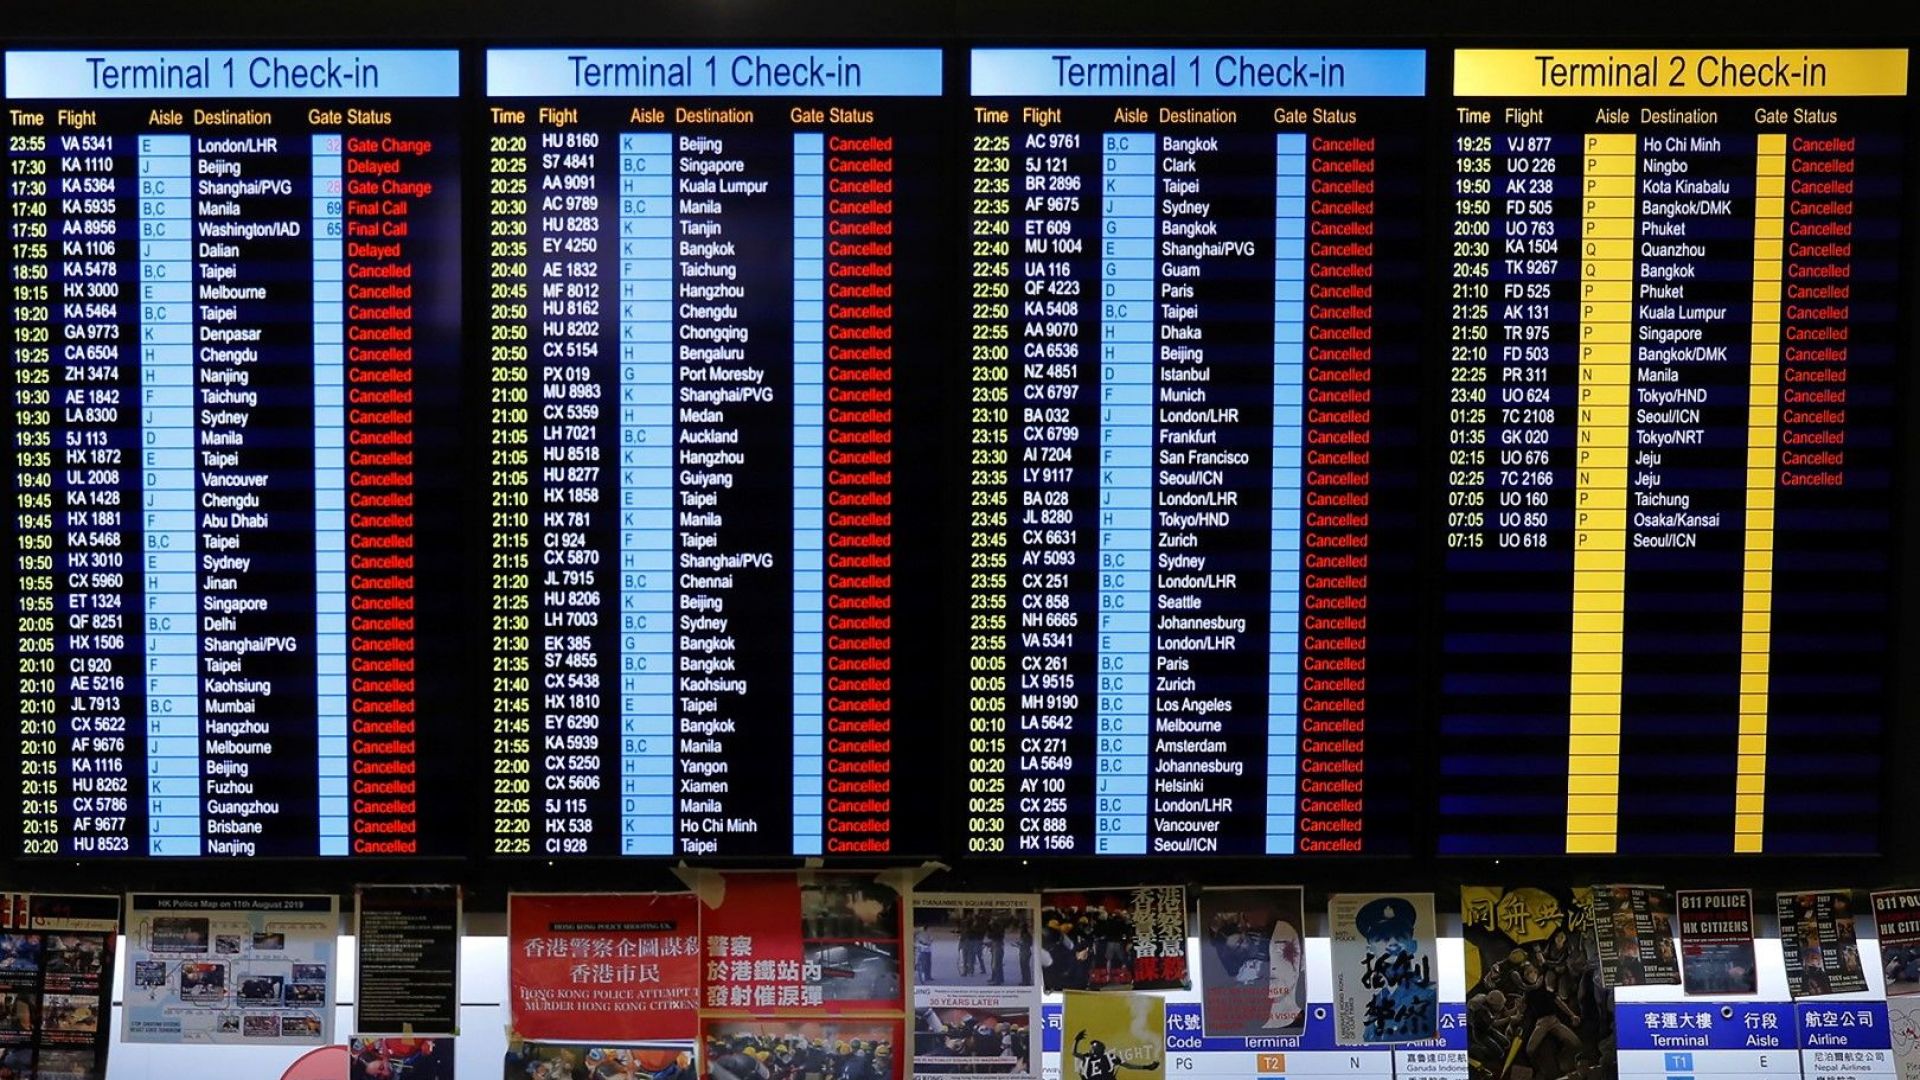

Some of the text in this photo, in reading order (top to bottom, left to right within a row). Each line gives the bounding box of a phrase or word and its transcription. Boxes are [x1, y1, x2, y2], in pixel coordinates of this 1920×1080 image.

[86, 57, 378, 88] Terminal 1 Check-in
[568, 56, 860, 87] Terminal 1 Check-in
[1052, 56, 1344, 87] Terminal 1 Check-in
[1535, 56, 1825, 87] Terminal 2 Check-in
[10, 109, 391, 129] Time Flight Aisle Destination Gate Status
[1457, 108, 1837, 127] Time Flight Aisle Destination Gate Status
[10, 136, 45, 151] 23:55
[61, 136, 80, 151] VA
[82, 136, 112, 151] 5341
[143, 139, 150, 152] E
[198, 138, 277, 153] London/LHR
[348, 138, 378, 152] Gate
[381, 138, 431, 155] Change
[1457, 137, 1854, 152] 19:25 VJ 877 P Ho Chi Minh Cancelled
[972, 510, 1368, 529] 23:45 JL 8280 H Tokyo/HND Cancelled
[1449, 512, 1719, 526] 07:05 UO 850 P Osaka/Kansai
[493, 612, 890, 633] 21:30 LH 7003 B,C Sydney Cancelled
[24, 837, 416, 856] 20:20 HU 8523 K Nanjing Cancelled
[495, 838, 889, 855] 22:25 CI 928 F Taipei Cancelled
[969, 835, 1361, 851] 00:30 HX 1566 E Seoul/ICN Cancelled
[158, 900, 170, 908] HK
[173, 900, 197, 908] Police
[201, 900, 217, 909] Map
[234, 900, 251, 908] 11th
[255, 900, 281, 909] August
[1682, 895, 1746, 909] 811 POLICE
[1877, 898, 1896, 910] 811
[1467, 895, 1595, 934] 同舟共濟
[1683, 921, 1748, 934] HK CITIZENS
[1880, 924, 1895, 934] HK
[707, 935, 752, 957] 警察
[570, 964, 660, 984] 香港市民
[520, 987, 688, 999] HONG KONG POLICE ATTEMPT
[707, 985, 824, 1006] 發射催淚彈
[525, 1000, 574, 1011] MURDER
[578, 1001, 611, 1011] HONG
[614, 1001, 646, 1011] KONG
[1644, 1012, 1712, 1029] 客運大樓
[1744, 1012, 1778, 1029] 行段
[1806, 1012, 1873, 1028] 航空公司
[1167, 1036, 1202, 1048] Code
[1245, 1036, 1300, 1048] Terminal
[1652, 1034, 1709, 1046] Terminal
[1746, 1034, 1779, 1046] Aisle
[1809, 1034, 1848, 1045] Airline
[1176, 1058, 1192, 1070] PG
[1264, 1057, 1280, 1070] T2
[1350, 1057, 1359, 1068] N
[1407, 1064, 1436, 1072] Garuda
[1672, 1056, 1685, 1068] T1
[1760, 1056, 1767, 1067] E
[1814, 1063, 1871, 1072] Nepal Airlines
